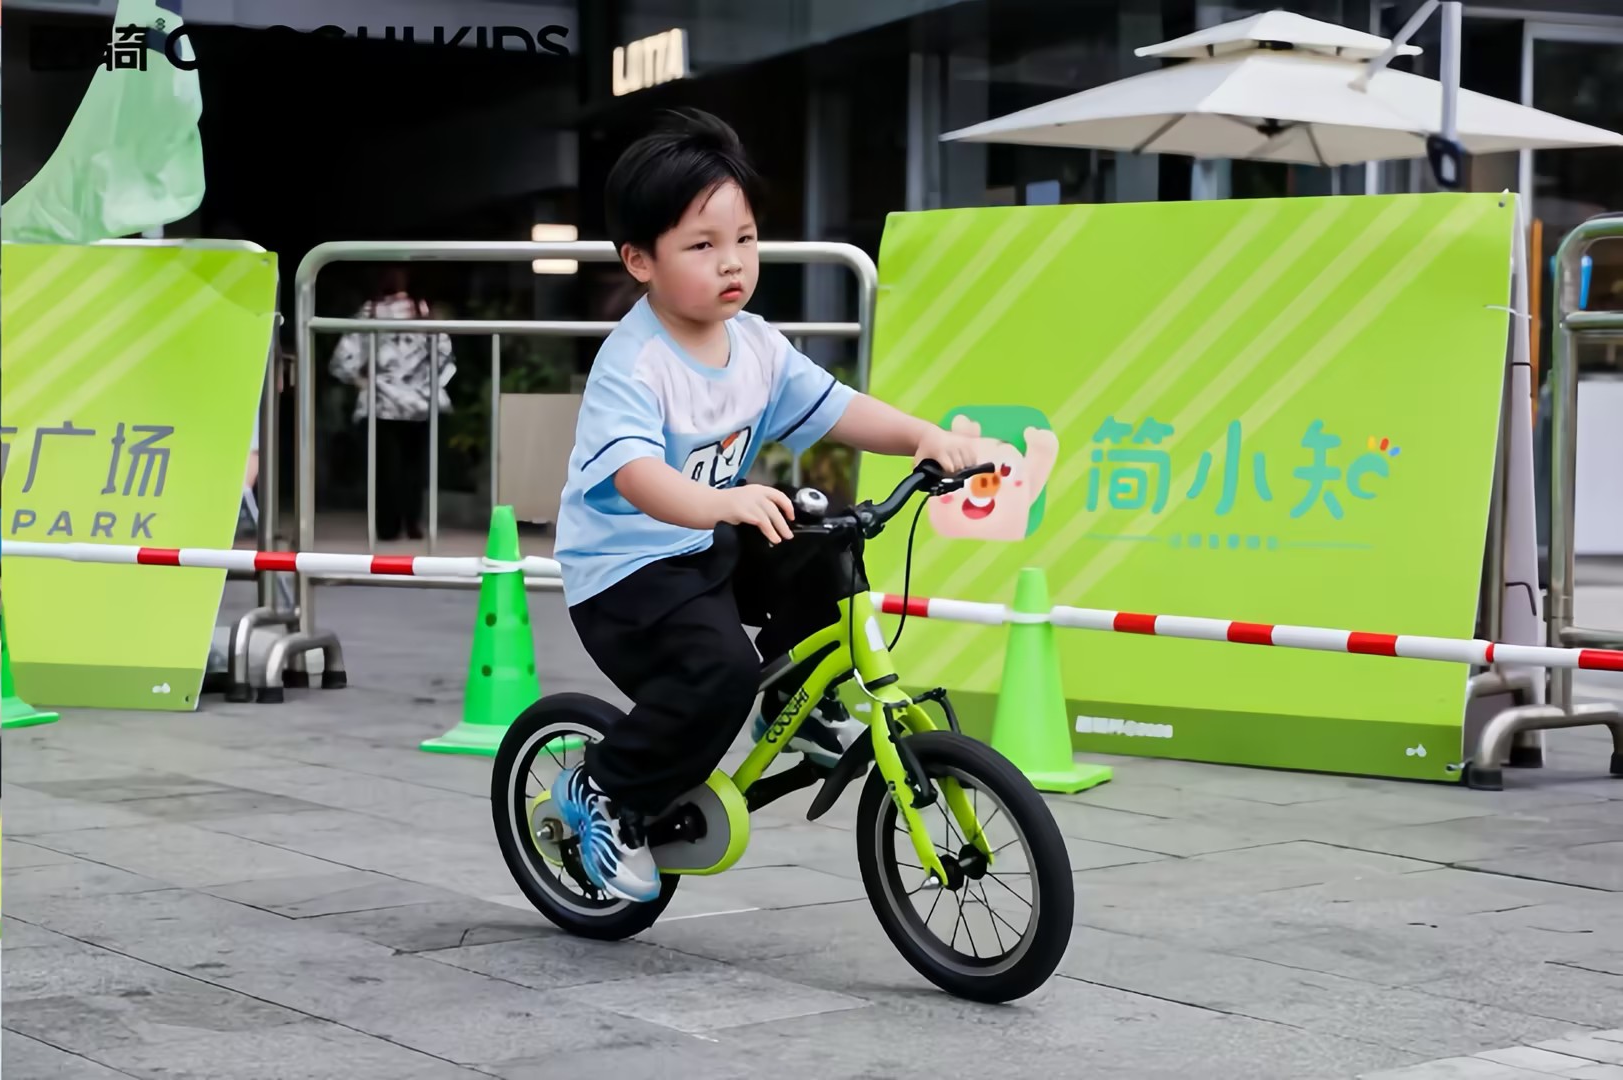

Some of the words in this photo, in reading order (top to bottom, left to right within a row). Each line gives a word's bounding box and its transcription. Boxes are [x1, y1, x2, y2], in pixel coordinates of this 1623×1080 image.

[1086, 416, 1390, 520] 简小知
[11, 509, 157, 539] PARK
